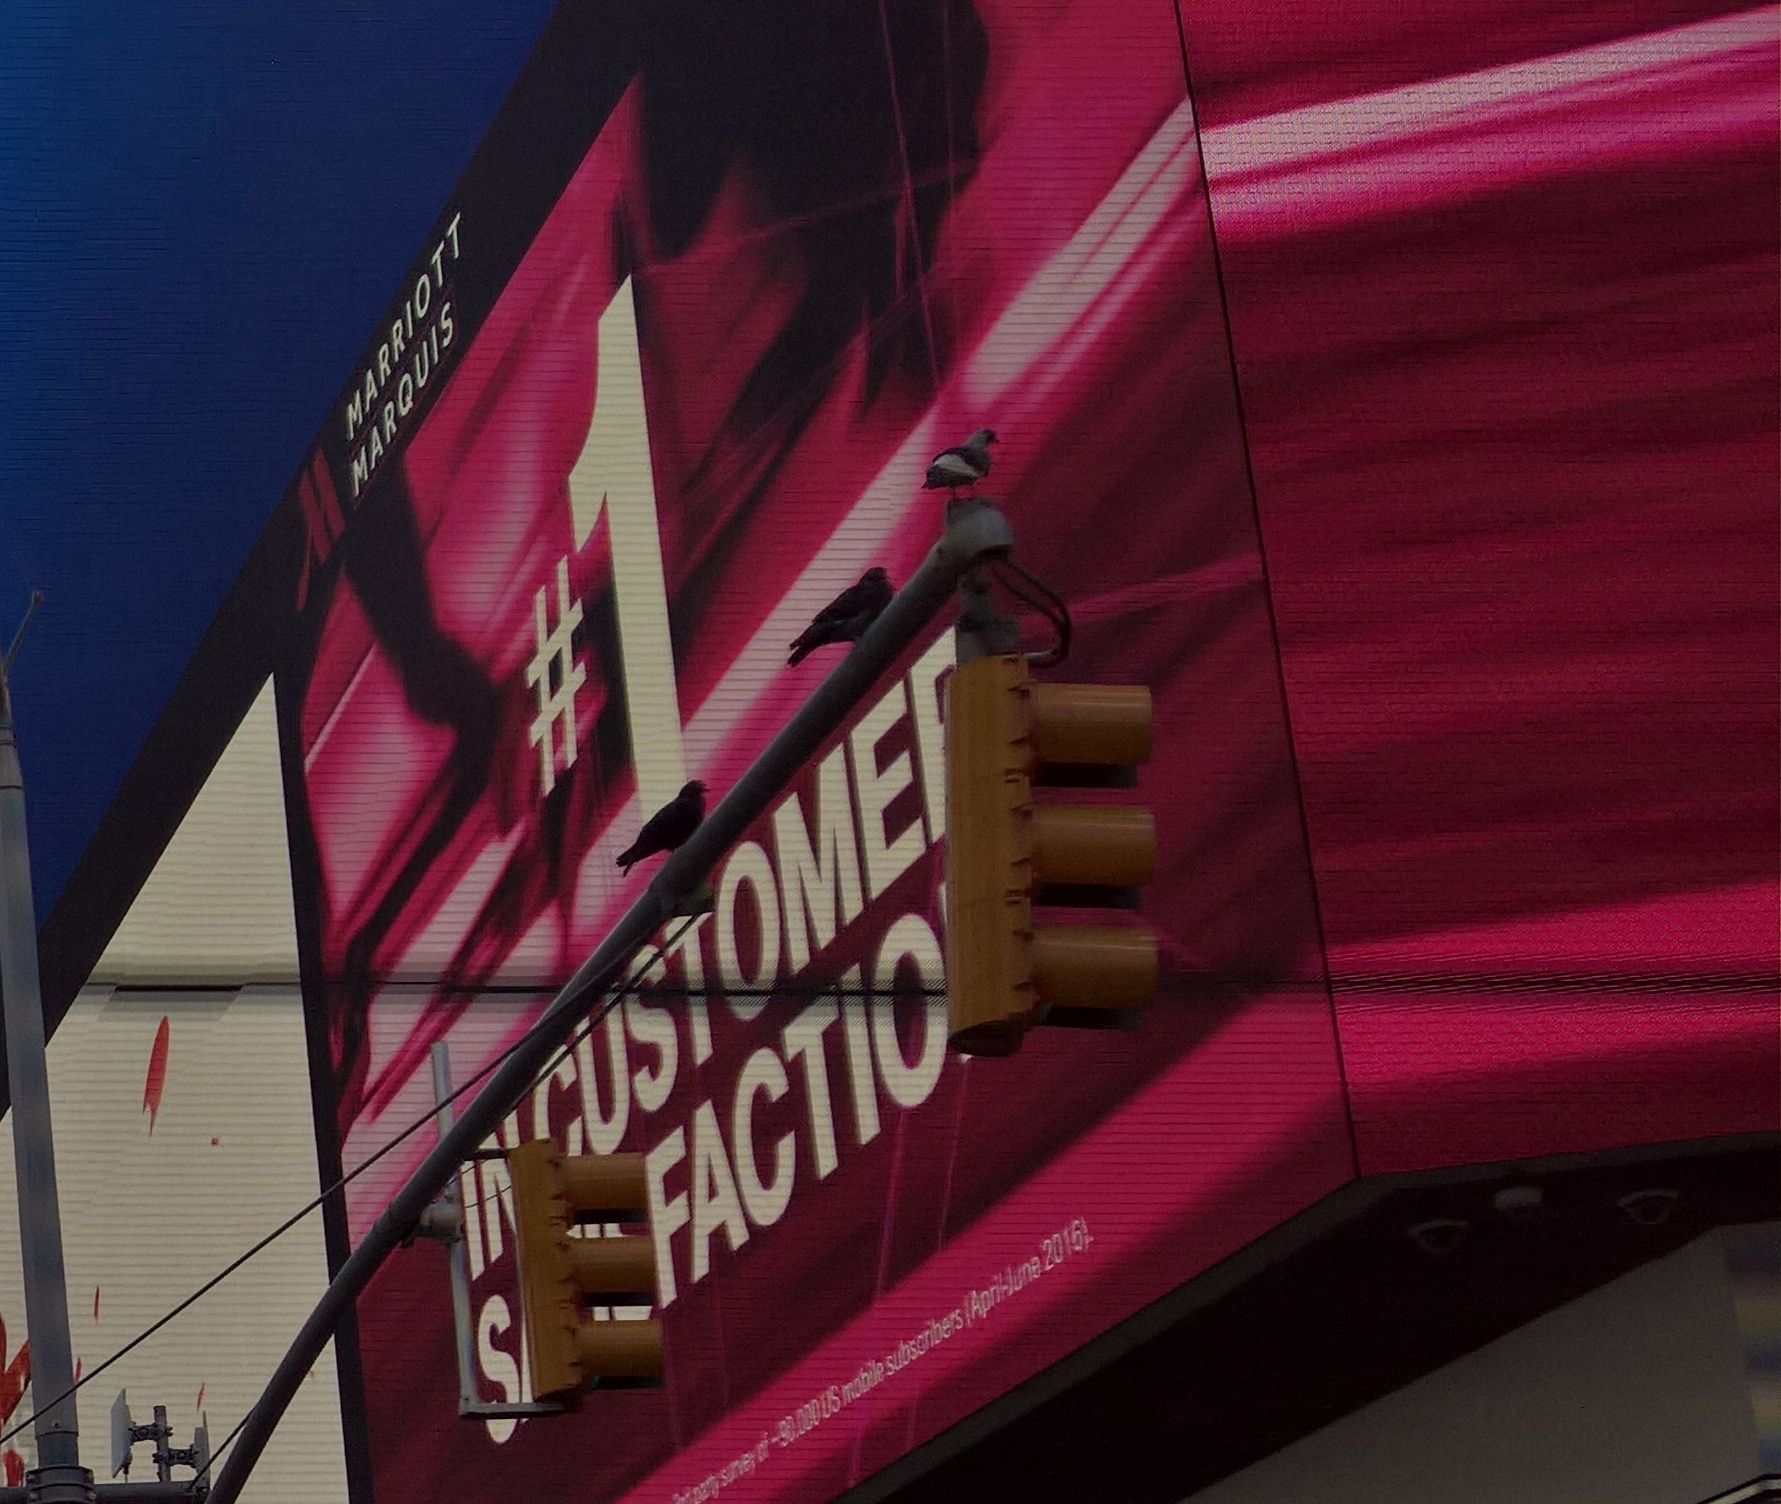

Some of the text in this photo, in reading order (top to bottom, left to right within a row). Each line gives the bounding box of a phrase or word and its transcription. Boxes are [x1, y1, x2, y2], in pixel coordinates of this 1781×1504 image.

[345, 211, 463, 440] MARRIOTT
[352, 302, 455, 498] MARQUIS
[527, 273, 688, 800] #1
[841, 1359, 886, 1407] mobile
[886, 1307, 965, 1376] subscribers
